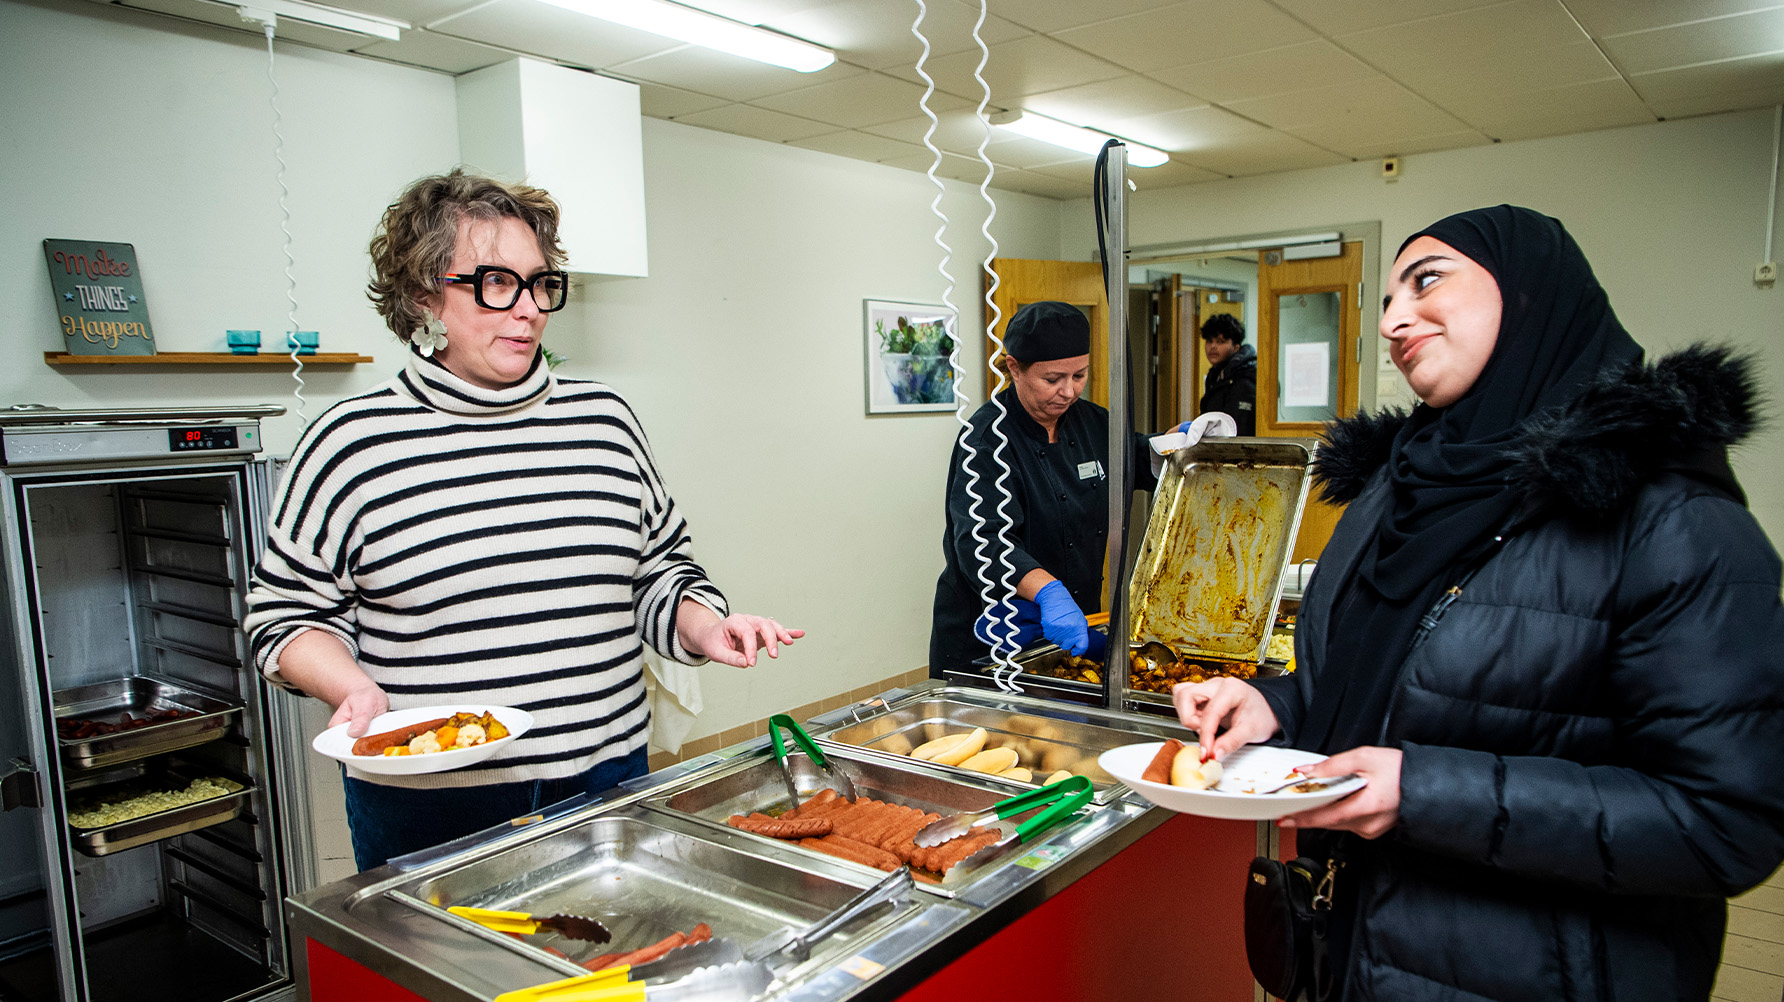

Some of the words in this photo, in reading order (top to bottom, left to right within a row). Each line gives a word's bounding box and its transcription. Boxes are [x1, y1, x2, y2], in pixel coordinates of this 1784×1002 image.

[53, 248, 133, 280] Make
[75, 285, 129, 312] THINGS
[62, 315, 153, 349] Happen
[186, 431, 201, 441] 80
